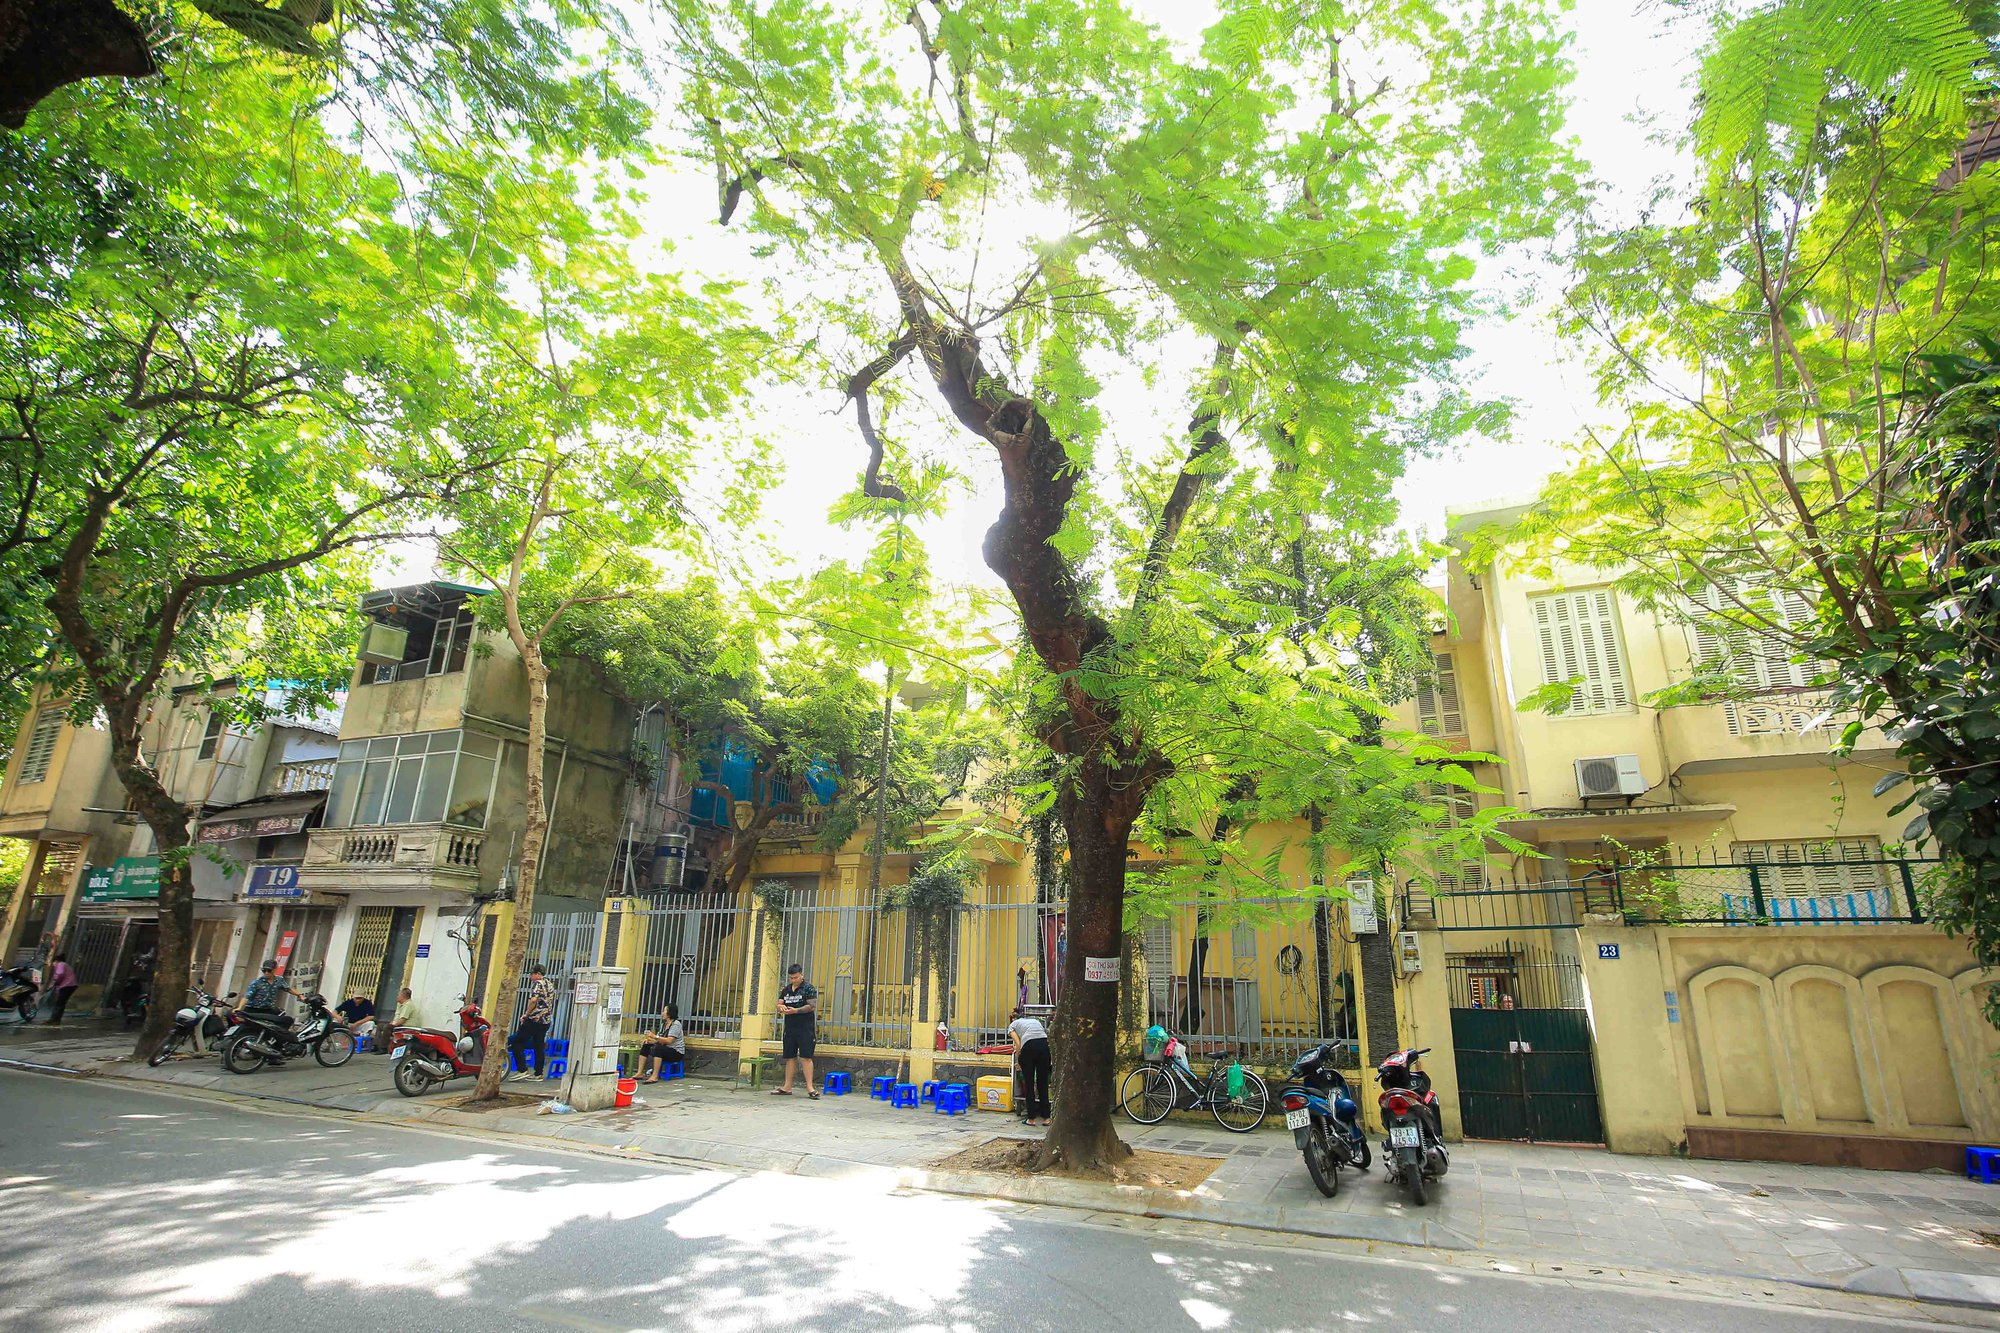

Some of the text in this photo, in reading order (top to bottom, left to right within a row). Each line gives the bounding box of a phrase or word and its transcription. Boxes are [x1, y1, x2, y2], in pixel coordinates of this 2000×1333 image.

[265, 867, 292, 886] 19
[1601, 945, 1617, 957] 23
[1088, 970, 1102, 980] 0937
